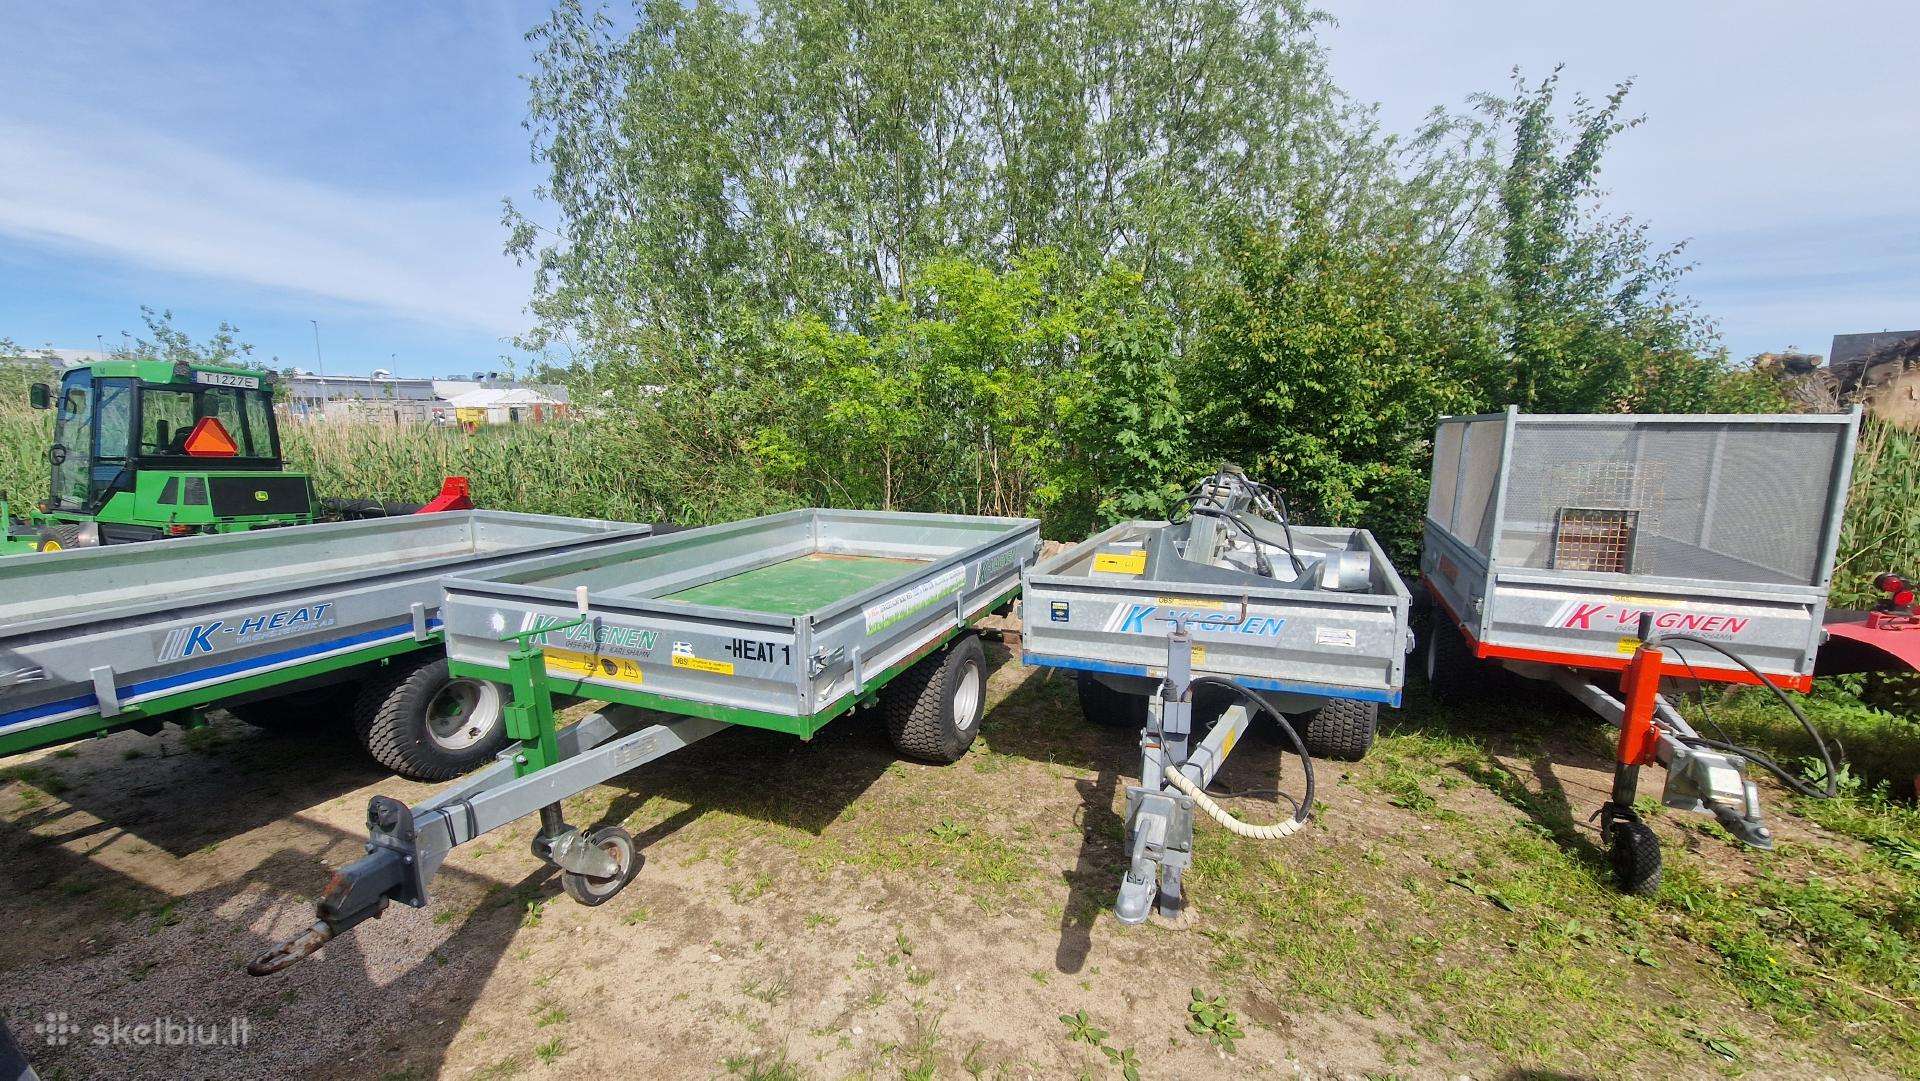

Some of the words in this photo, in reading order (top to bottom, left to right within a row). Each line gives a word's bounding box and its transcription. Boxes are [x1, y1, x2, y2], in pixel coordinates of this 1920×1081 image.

[205, 373, 254, 388] T1227E
[182, 602, 332, 657] K-HEAT
[1564, 603, 1750, 633] K-VGNEN
[781, 645, 790, 666] 1
